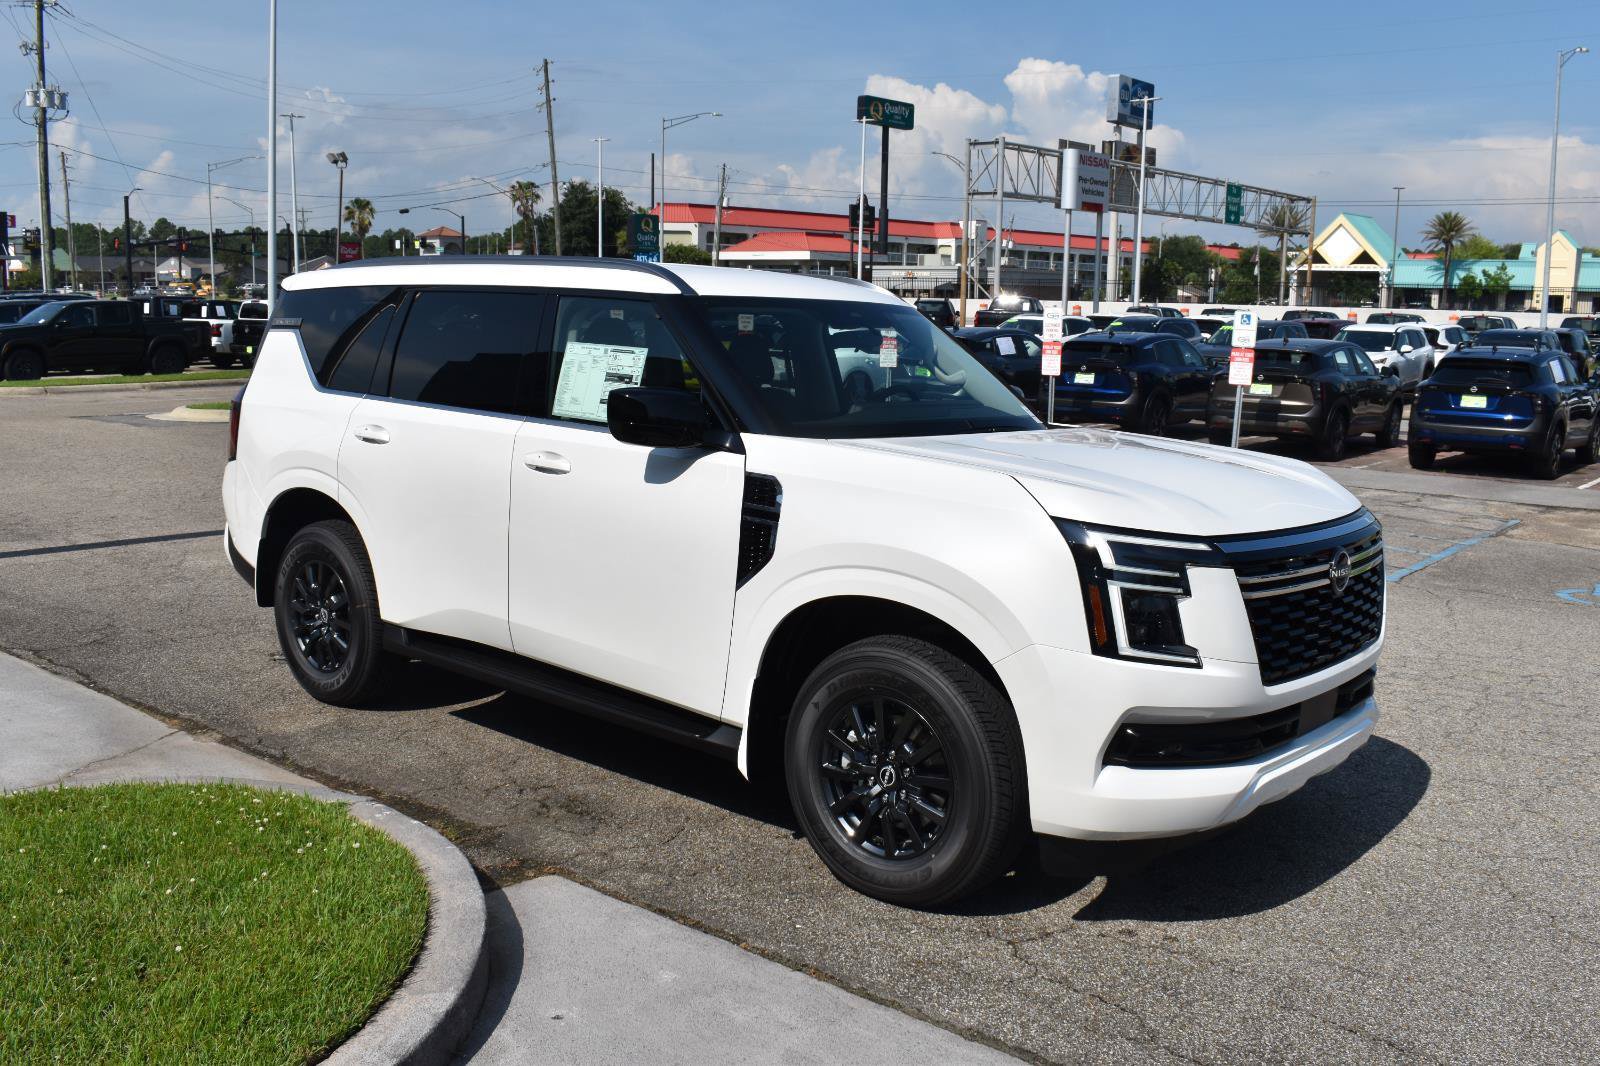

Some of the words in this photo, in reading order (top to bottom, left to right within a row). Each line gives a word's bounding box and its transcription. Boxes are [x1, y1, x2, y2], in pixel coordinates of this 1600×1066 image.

[884, 102, 910, 118] Quality
[1080, 154, 1109, 169] NISSAN
[1078, 175, 1109, 188] Pre-Owned
[1081, 187, 1105, 197] Vehicles
[637, 232, 657, 244] Quality
